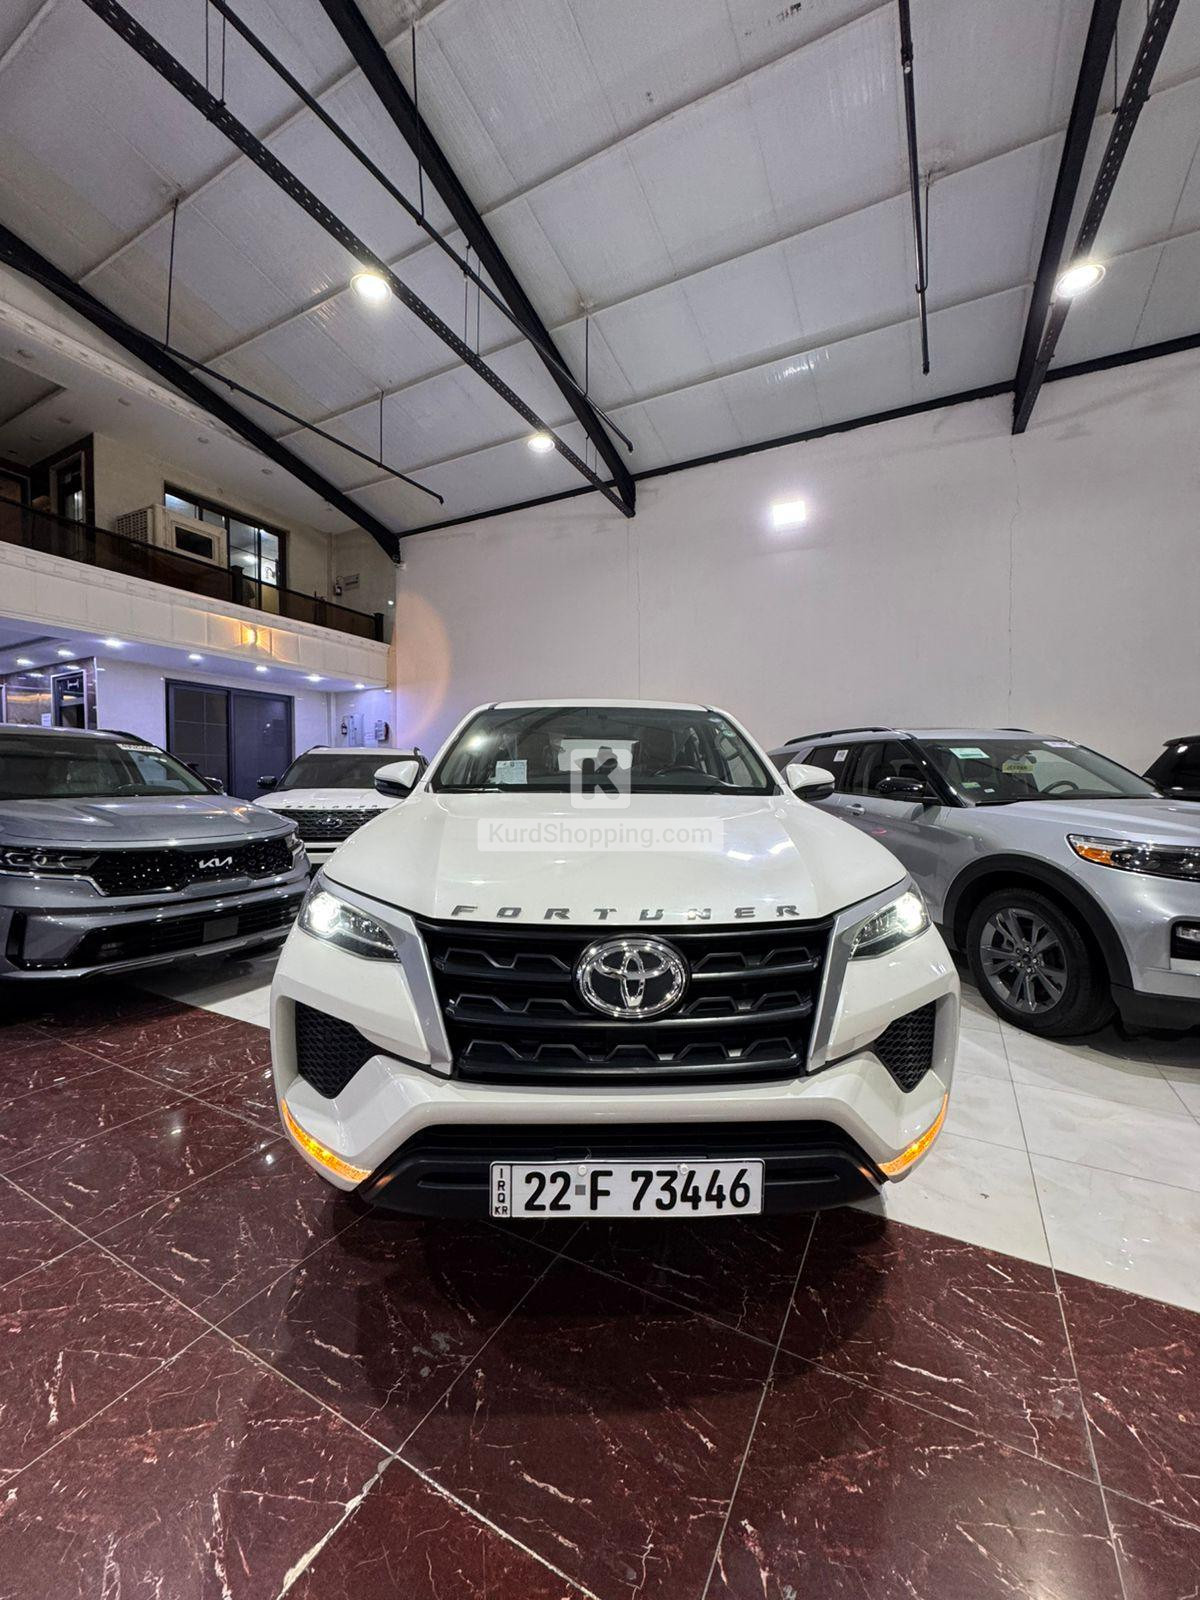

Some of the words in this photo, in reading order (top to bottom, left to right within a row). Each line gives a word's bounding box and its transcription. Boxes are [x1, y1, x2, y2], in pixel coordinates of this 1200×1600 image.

[451, 904, 800, 921] FORTUNER
[524, 1171, 572, 1211] 22
[589, 1170, 614, 1211] F
[630, 1168, 751, 1212] 73446
